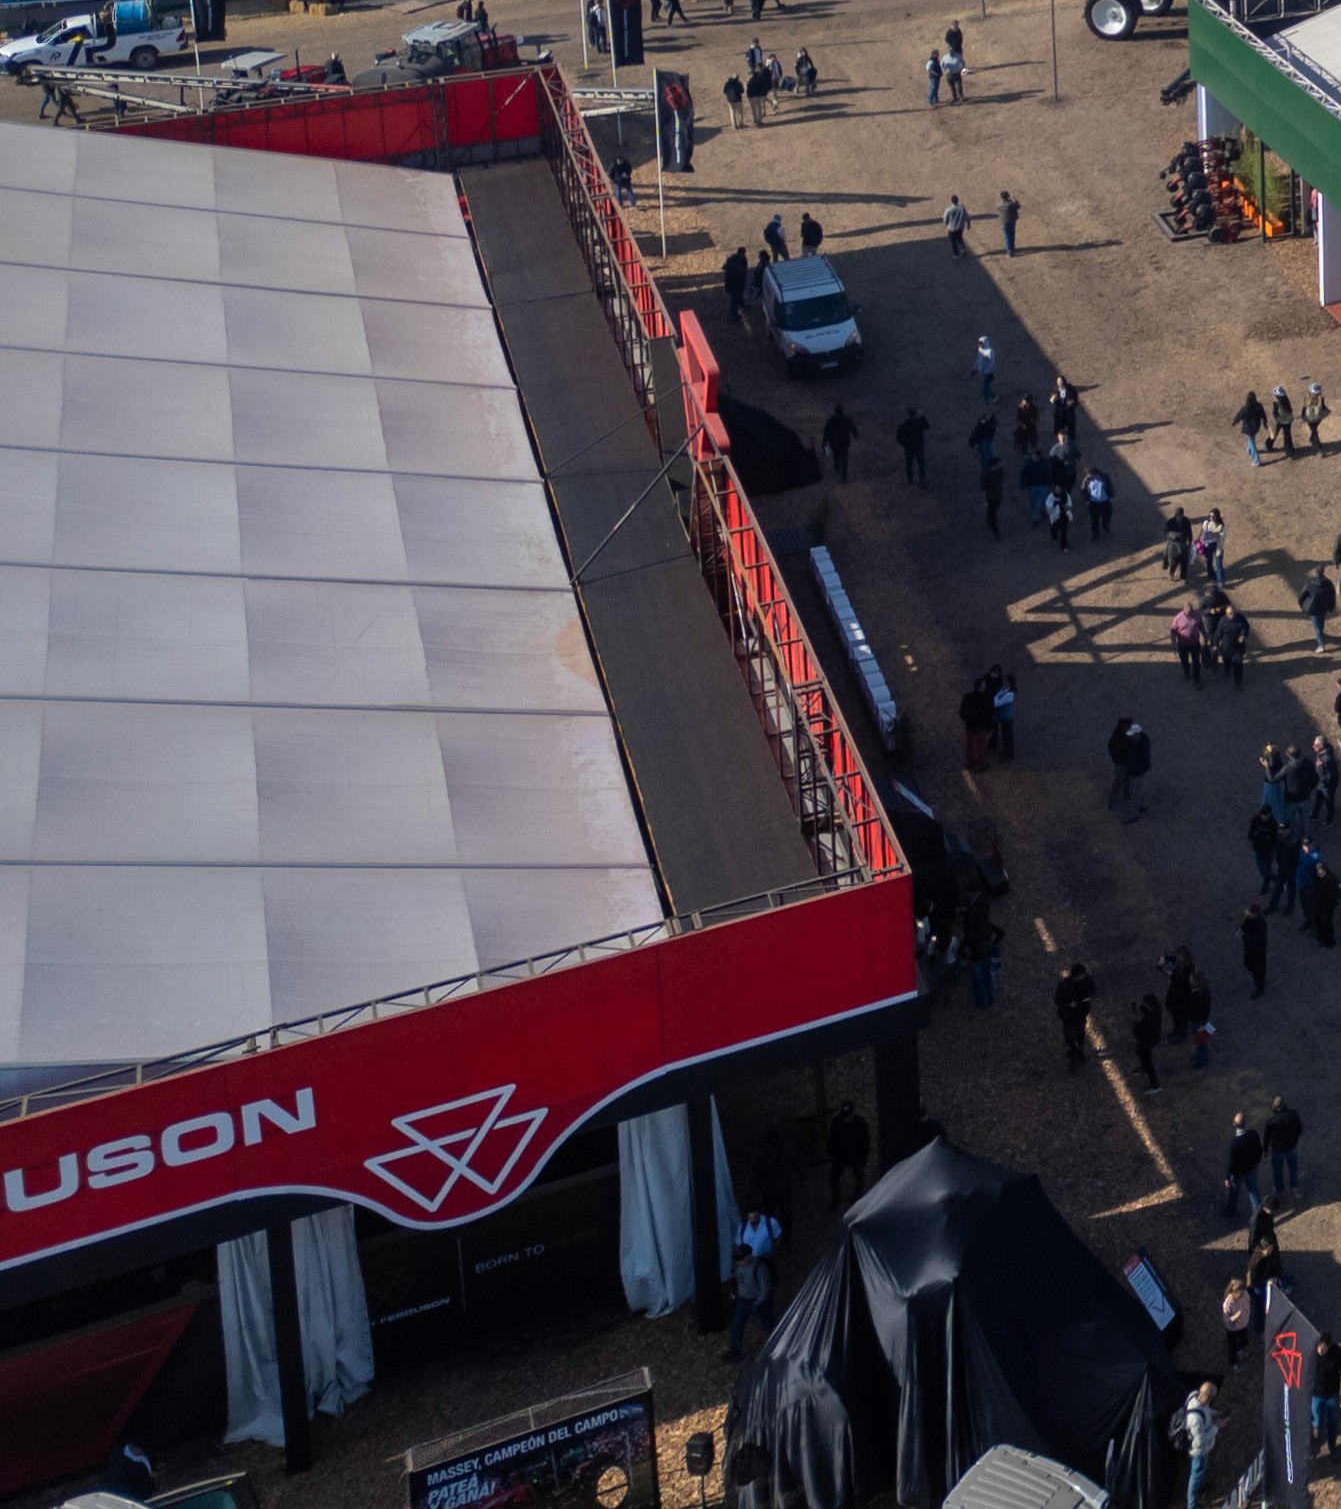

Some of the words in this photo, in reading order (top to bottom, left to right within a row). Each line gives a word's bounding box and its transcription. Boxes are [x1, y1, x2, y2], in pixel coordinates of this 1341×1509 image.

[3, 1087, 317, 1214] USON
[474, 1252, 519, 1274] BORN
[525, 1243, 546, 1257] TO
[379, 1296, 450, 1325] FERGUSON
[427, 1458, 482, 1488] MASSEY,
[485, 1435, 546, 1468] CAMPEÓN
[548, 1425, 573, 1448] DEL
[575, 1408, 620, 1439] CAMPO
[427, 1472, 479, 1506] PATEÁ
